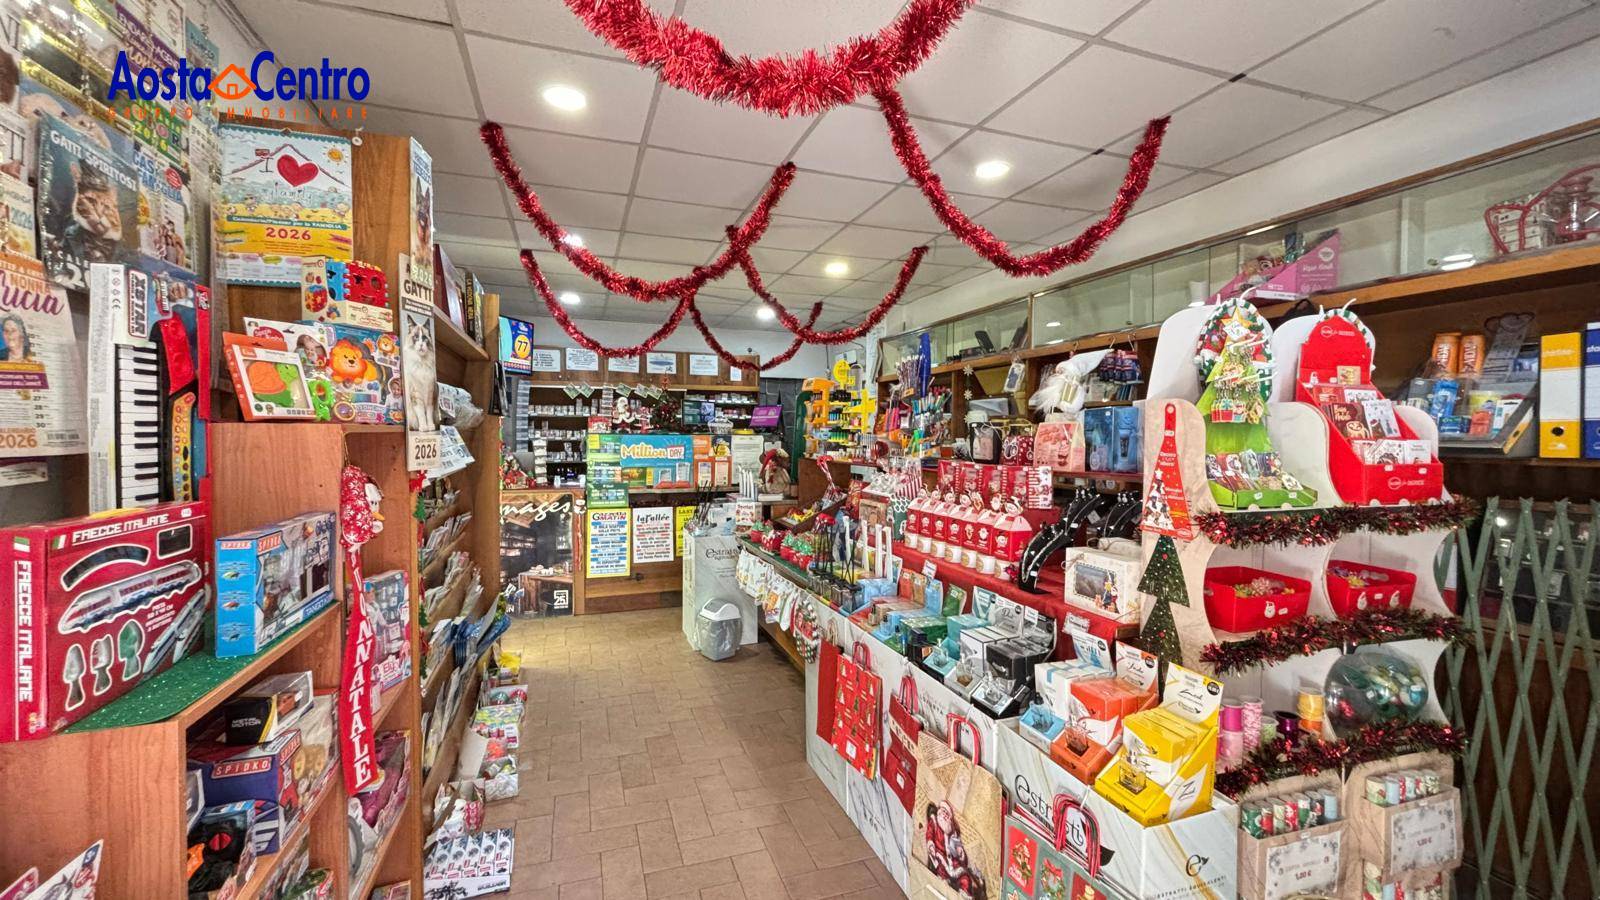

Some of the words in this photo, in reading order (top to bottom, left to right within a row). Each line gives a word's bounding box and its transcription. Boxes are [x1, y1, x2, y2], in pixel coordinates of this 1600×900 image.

[50, 130, 82, 158] GATTI
[85, 151, 138, 192] SPIRITOSI
[266, 227, 312, 241] 2026
[404, 279, 432, 303] GATTI
[517, 340, 528, 352] 77
[0, 434, 37, 448] 2026
[621, 442, 667, 458] Million
[415, 444, 437, 460] 2026
[123, 514, 169, 533] ITALIANE
[19, 629, 33, 702] ITALIANE
[350, 637, 372, 790] NATALE
[1015, 775, 1084, 847] estrti
